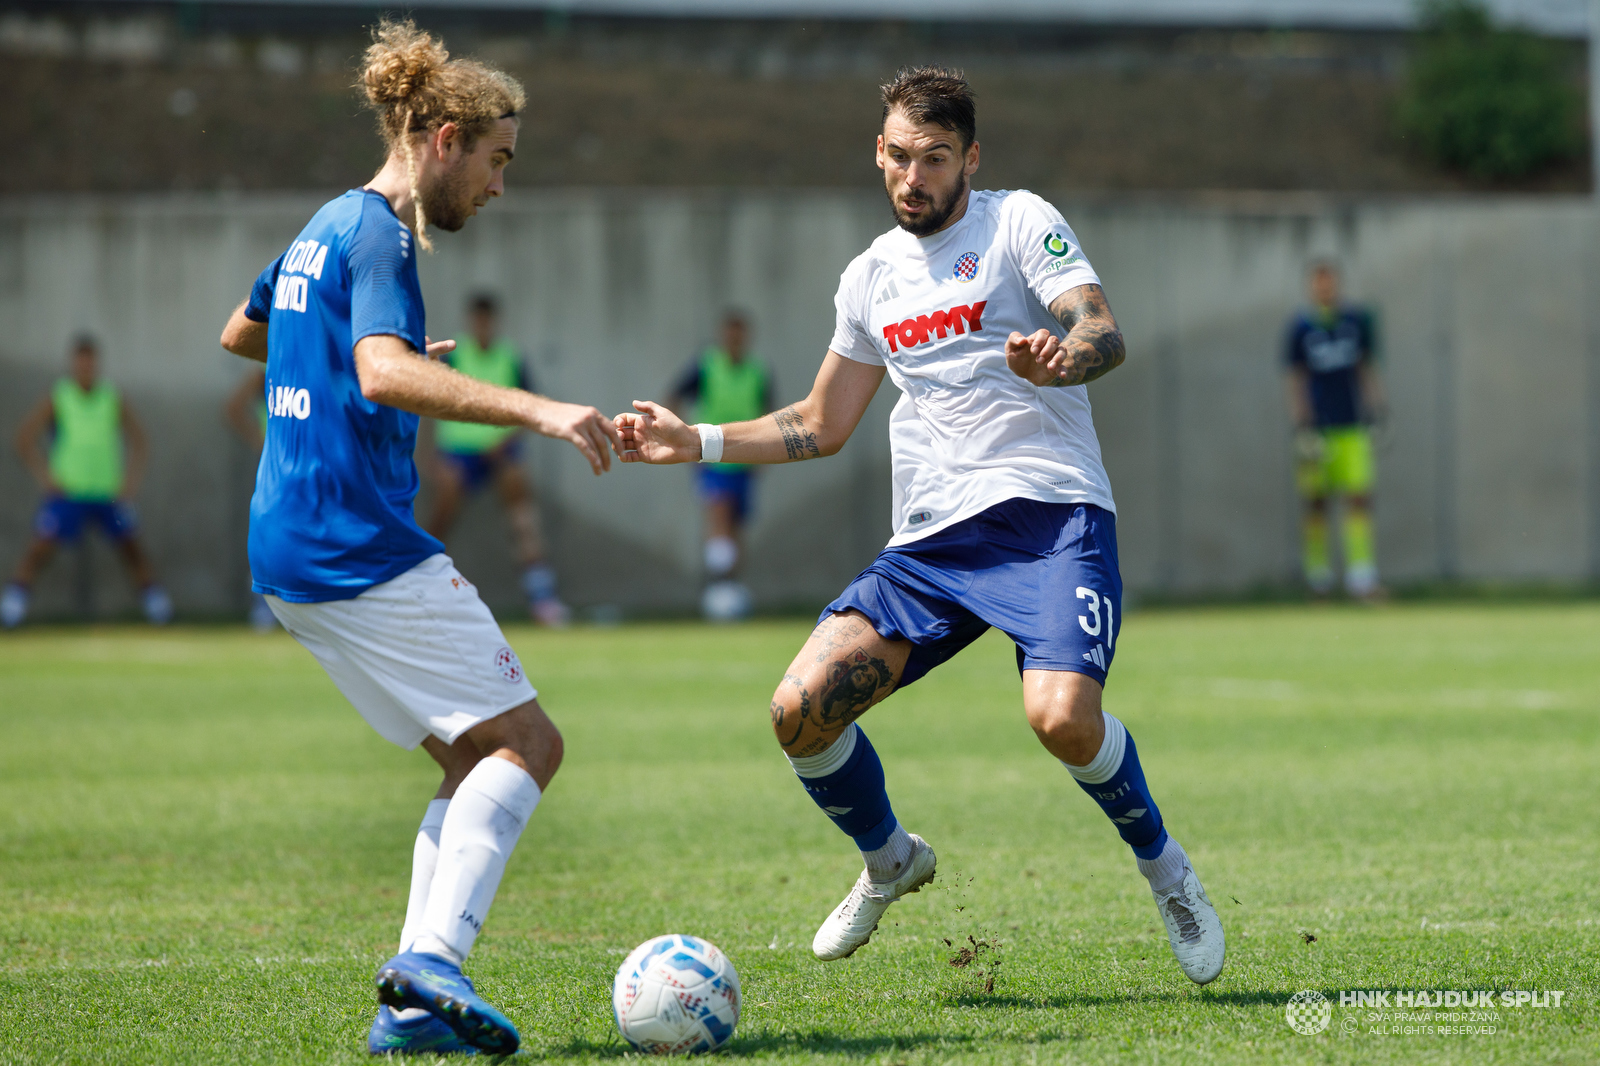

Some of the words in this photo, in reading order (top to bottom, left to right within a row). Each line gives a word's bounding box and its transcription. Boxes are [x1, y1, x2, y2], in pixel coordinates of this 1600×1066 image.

[882, 300, 988, 353] TOMMY
[274, 386, 311, 420] JKO
[1075, 586, 1113, 649] 31
[1095, 781, 1131, 800] 1911
